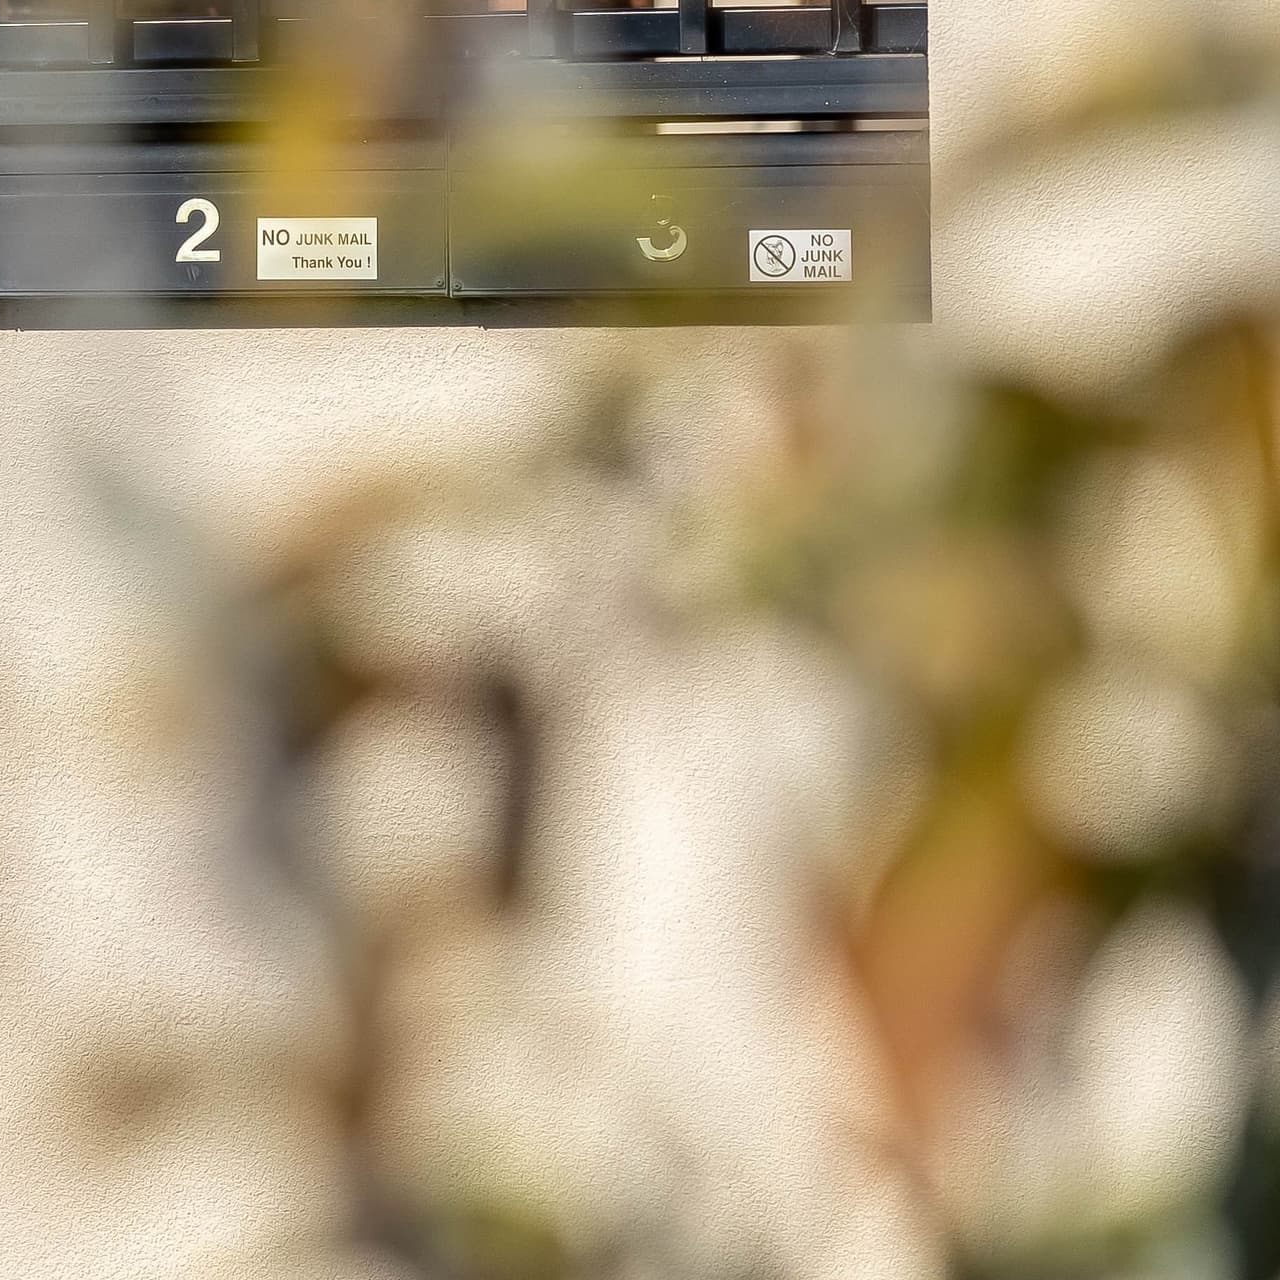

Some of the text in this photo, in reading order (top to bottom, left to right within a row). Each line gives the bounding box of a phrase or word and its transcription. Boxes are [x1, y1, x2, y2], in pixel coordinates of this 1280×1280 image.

[175, 197, 221, 263] 2
[262, 229, 372, 246] NO JUNK MAIL
[810, 233, 834, 247] NO
[292, 256, 334, 268] Thank
[337, 256, 362, 268] You
[800, 249, 844, 263] JUNK
[803, 265, 843, 278] MAIL
